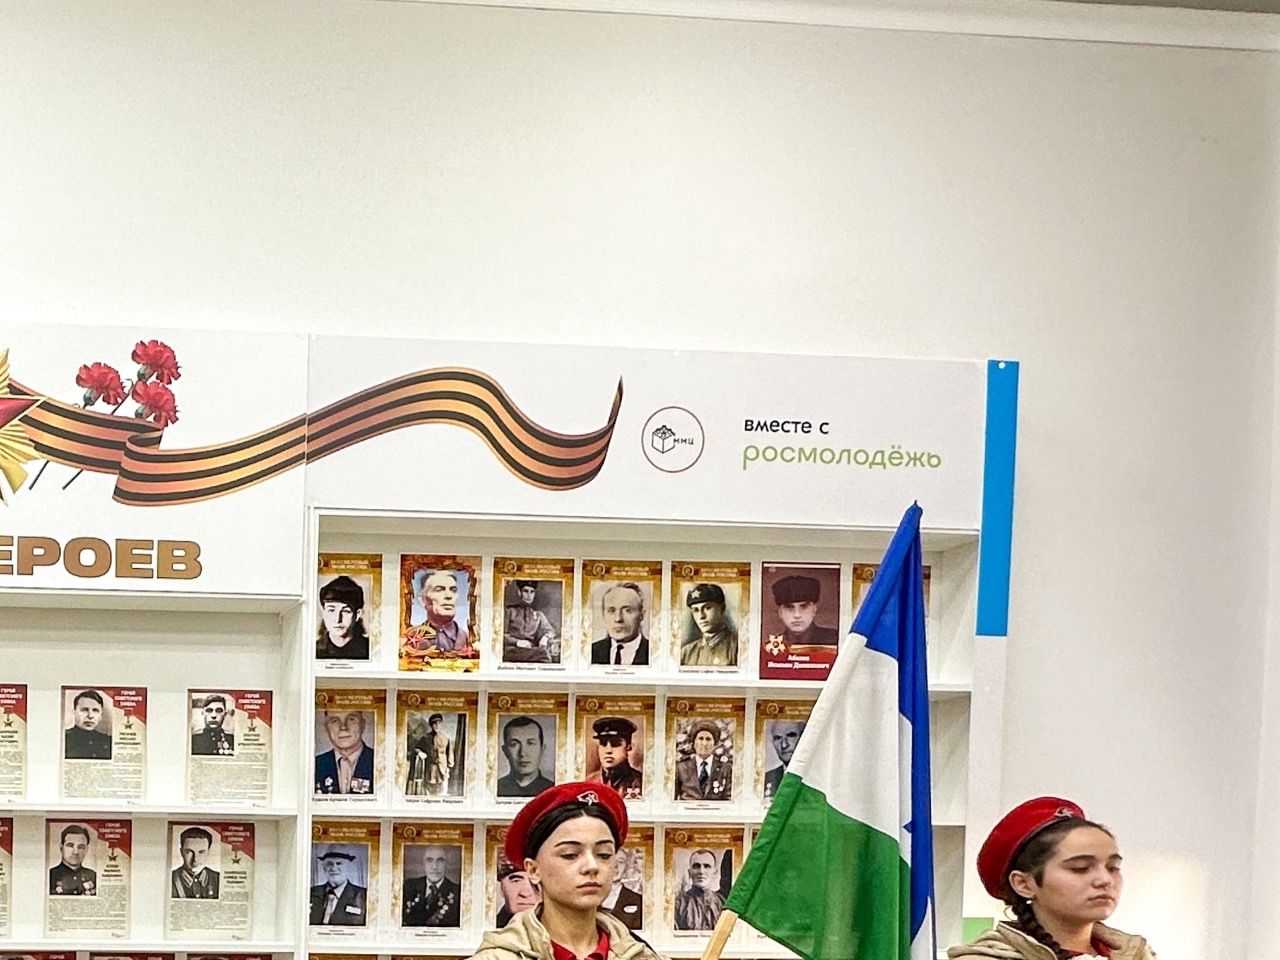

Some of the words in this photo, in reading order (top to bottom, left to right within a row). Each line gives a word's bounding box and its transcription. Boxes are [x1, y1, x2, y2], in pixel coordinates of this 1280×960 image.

[743, 418, 812, 434] вместе
[819, 422, 830, 434] с
[742, 444, 942, 471] росмолодёжь
